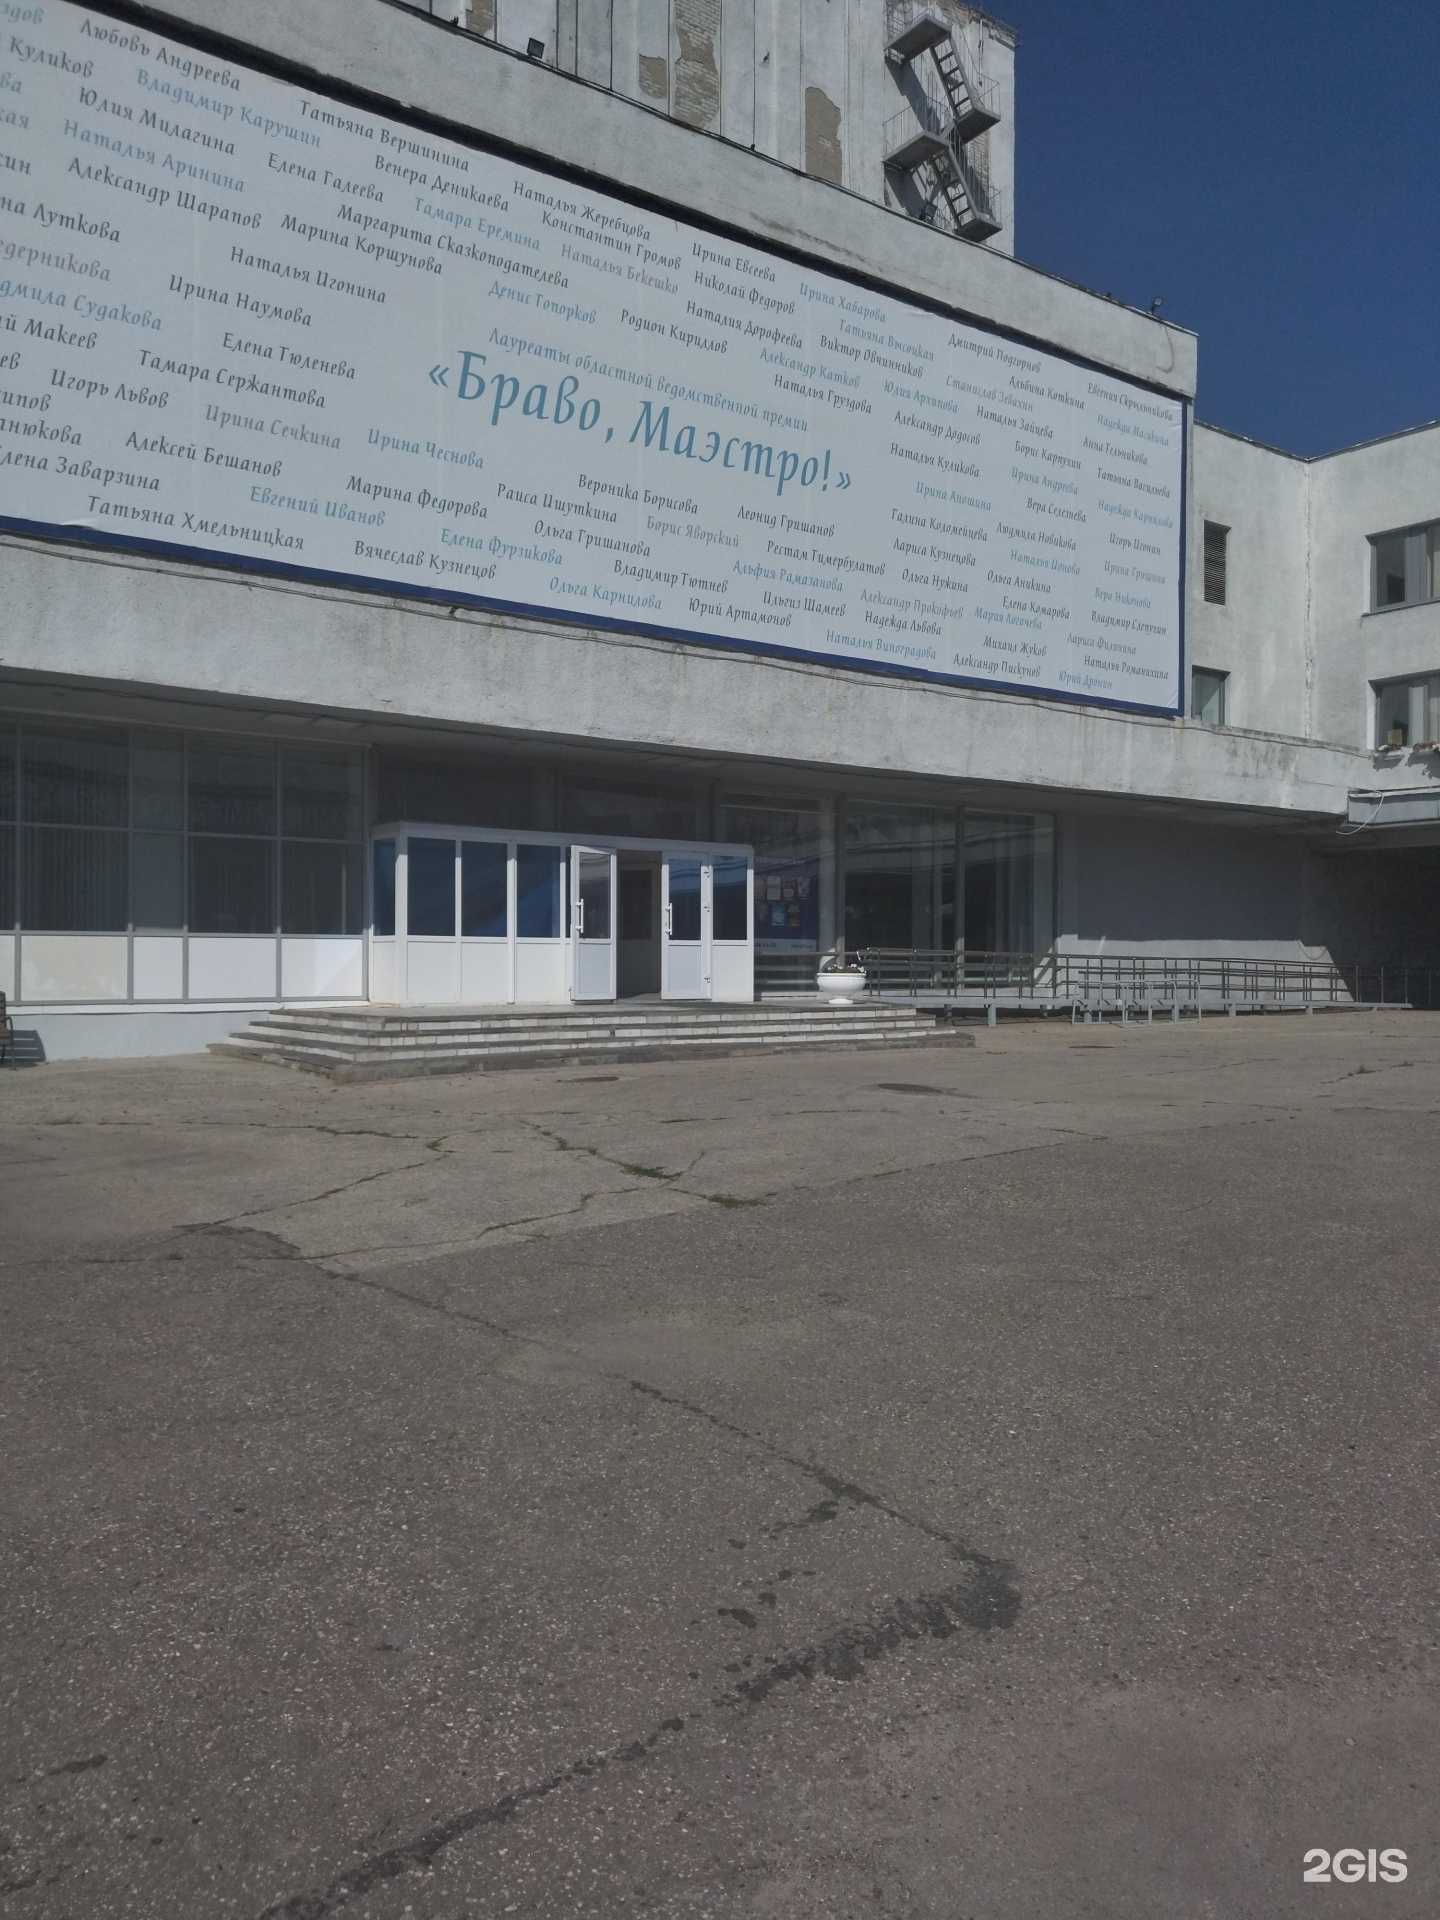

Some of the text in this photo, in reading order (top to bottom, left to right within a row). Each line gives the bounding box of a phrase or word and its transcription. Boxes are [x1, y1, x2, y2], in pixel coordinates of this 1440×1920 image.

[10, 36, 94, 77] Куликов
[80, 18, 240, 91] Любовь Андреева
[79, 86, 234, 155] Юлия Милагина
[137, 68, 320, 147] Владимир Карушин
[64, 119, 244, 192] Наталья Аринина
[300, 99, 469, 172] Татьяна Вершинина
[67, 157, 262, 229] Александр Шарапов
[268, 152, 383, 202] Елена Галеева
[375, 154, 508, 212] Венера Деникаева
[32, 203, 119, 243] Луткова
[415, 196, 539, 250] Тамара Еремина
[513, 180, 650, 241] Наталья Жеребцова
[280, 214, 442, 275] Марина Коршунова
[336, 204, 568, 288] Маргарита Сказкоподателева
[542, 210, 682, 270] Константин Громов
[561, 243, 622, 276] Наталья
[230, 245, 386, 303] Наталья Игонина
[692, 241, 775, 282] Ирина Евсеева
[73, 295, 161, 330] Судакова
[169, 273, 311, 326] Ирина Наумова
[487, 280, 530, 304] Денис
[694, 270, 795, 314] Николай Федоров
[23, 318, 98, 349] Макеев
[620, 308, 727, 354] Родион Кириллов
[743, 320, 802, 349] Дорофеева
[820, 334, 861, 362] Виктор
[947, 333, 993, 358] Дмитрий
[222, 331, 355, 379] Елена Тюленева
[51, 368, 169, 408] Игорь Львов
[140, 349, 325, 408] Тамара Сержантова
[489, 327, 807, 432] Лауреаты областной ведомственной премии
[774, 373, 872, 414] Наталья Груздова
[205, 404, 264, 432] Ирина
[428, 350, 851, 496] «Браво, Маэстро!»
[125, 431, 282, 477] Алексей Бешанов
[368, 428, 483, 469] Ирина Чеснова
[890, 442, 979, 477] Наталья Куликова
[55, 455, 159, 491] Заварзина
[578, 473, 698, 514] Вероника Борисова
[250, 485, 385, 526] Евгений Иванов
[345, 475, 487, 519] Марина Федорова
[497, 482, 617, 523] Раиса Ишуткина
[891, 507, 926, 527] Галина
[88, 495, 303, 550] Татьяна Хмельницкая
[440, 527, 483, 550] Елена
[534, 519, 650, 557] Ольга Гришанова
[737, 505, 835, 537] Леонид Гришанов
[354, 540, 496, 579] Вячеслав Кузнецов
[892, 536, 976, 566] Лариса Кузнецова
[549, 576, 587, 596] Ольга
[613, 559, 678, 588] Владимир
[901, 568, 929, 584] Ольга
[688, 597, 792, 627] Юрий Артамонов
[864, 609, 907, 632] Надежда
